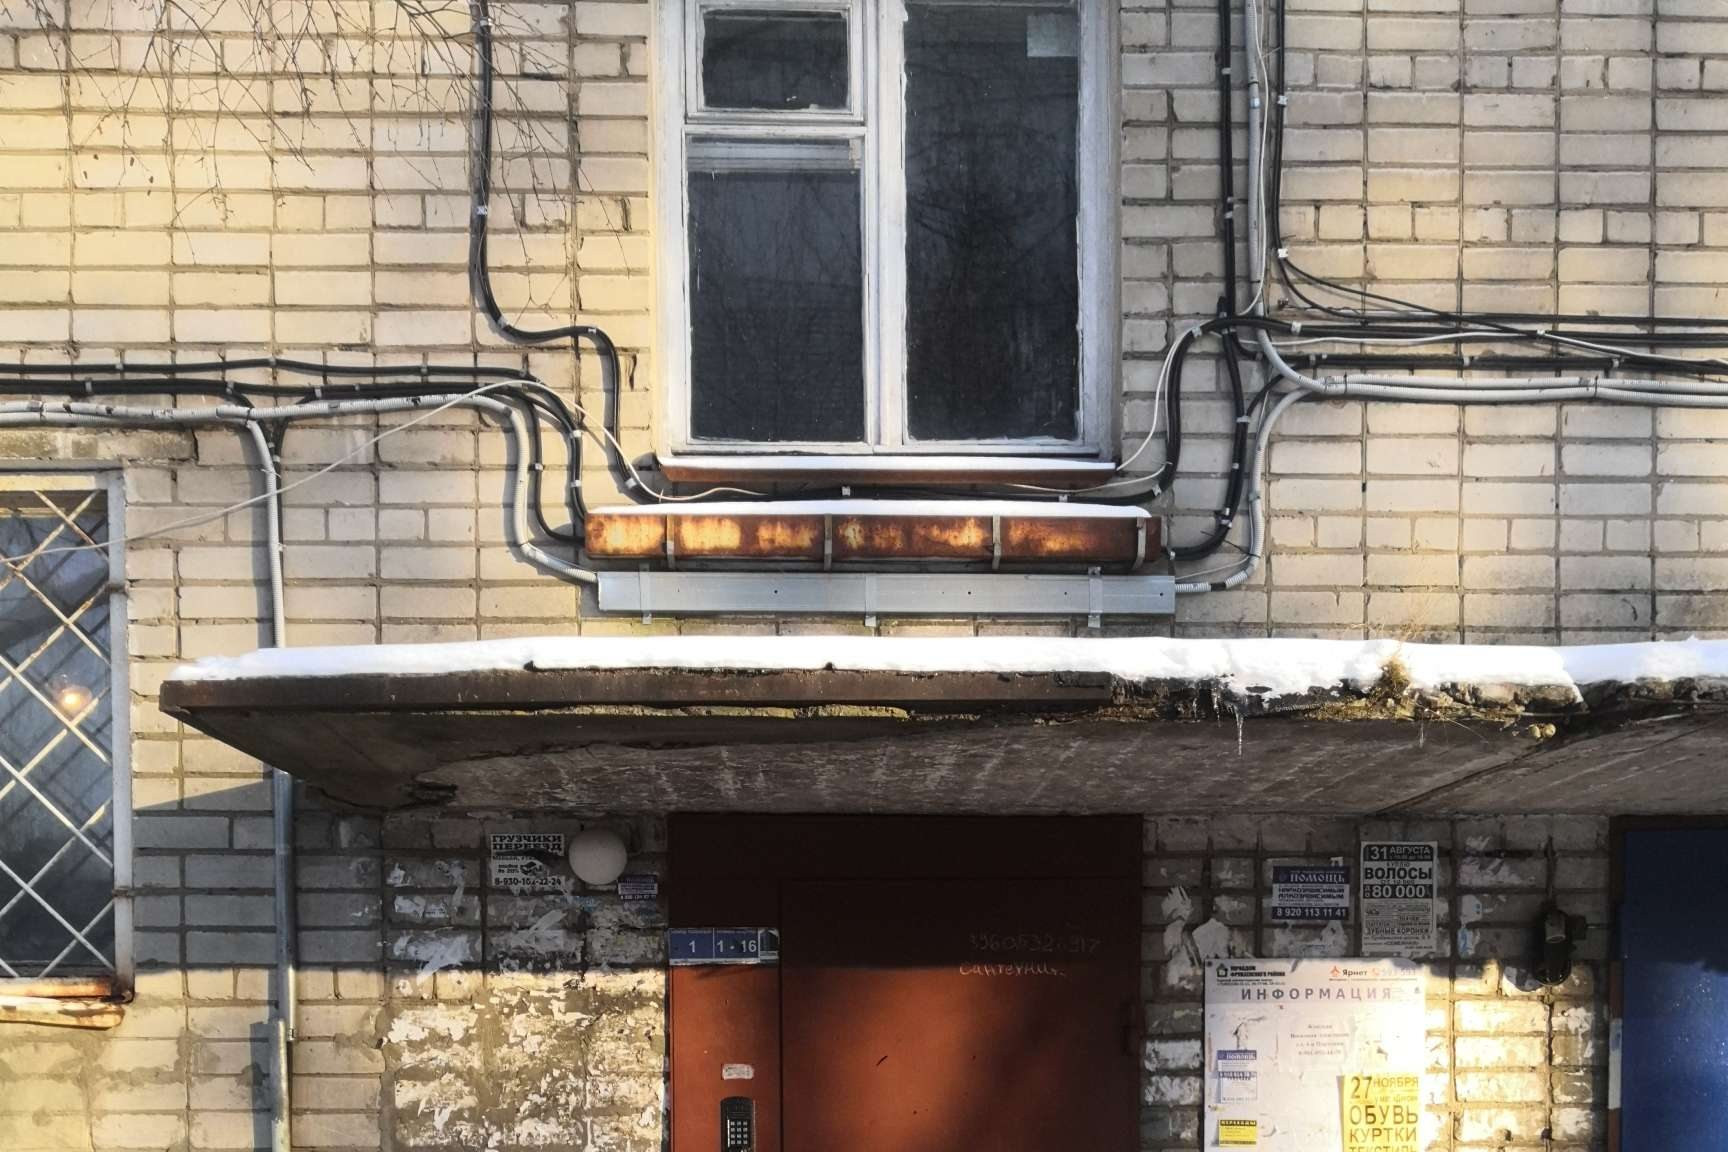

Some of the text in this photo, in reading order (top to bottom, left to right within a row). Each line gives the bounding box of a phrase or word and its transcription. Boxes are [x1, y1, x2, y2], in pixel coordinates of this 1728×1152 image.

[492, 835, 561, 843] ГРУЗЧИКИ
[492, 843, 562, 851] ПЕРЕЕЗД
[1370, 846, 1388, 860] 31
[1389, 846, 1431, 855] АВГУСТА
[1364, 867, 1433, 880] ВОЛОСЫ
[1372, 885, 1392, 898] 80
[1395, 885, 1426, 898] 000
[1276, 908, 1346, 917] 8 920 113 11 41
[688, 940, 696, 953] 1
[716, 940, 724, 953] 1
[740, 940, 758, 953] 16
[1241, 987, 1391, 1001] ИНФОРМАЦИЯ
[1350, 1076, 1373, 1099] 27
[1374, 1077, 1419, 1088] НОЯБРЯ
[1350, 1104, 1419, 1125] ОБУВЬ
[1349, 1127, 1417, 1143] КУРТКИ
